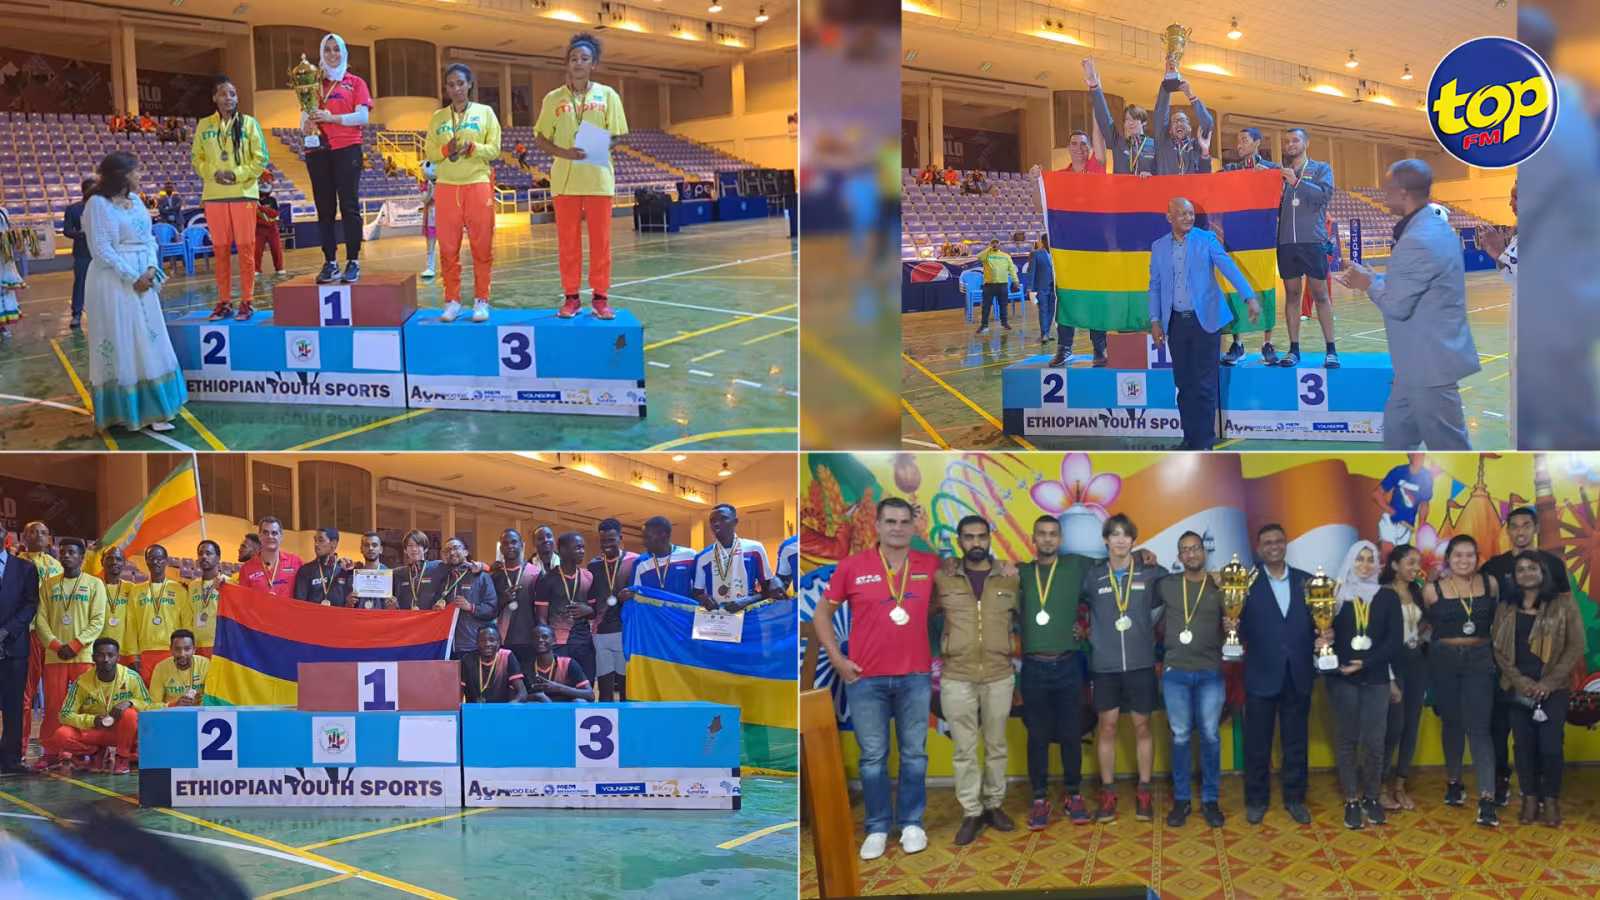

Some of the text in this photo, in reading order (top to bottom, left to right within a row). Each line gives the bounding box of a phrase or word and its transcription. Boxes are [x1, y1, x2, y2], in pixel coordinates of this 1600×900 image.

[324, 291, 350, 326] 1
[203, 331, 227, 365] 2
[501, 332, 531, 370] 3
[187, 379, 391, 398] ETHIOPIAN YOUTH SPORTS
[1043, 373, 1065, 404] 2
[1299, 372, 1325, 405] 3
[1027, 416, 1182, 430] ETHIOPIAN YOUTH SPO
[363, 668, 396, 711] 1
[201, 718, 233, 761] 2
[578, 715, 615, 760] 3
[176, 780, 443, 796] ETHIOPIAN YOUTH SPORTS
